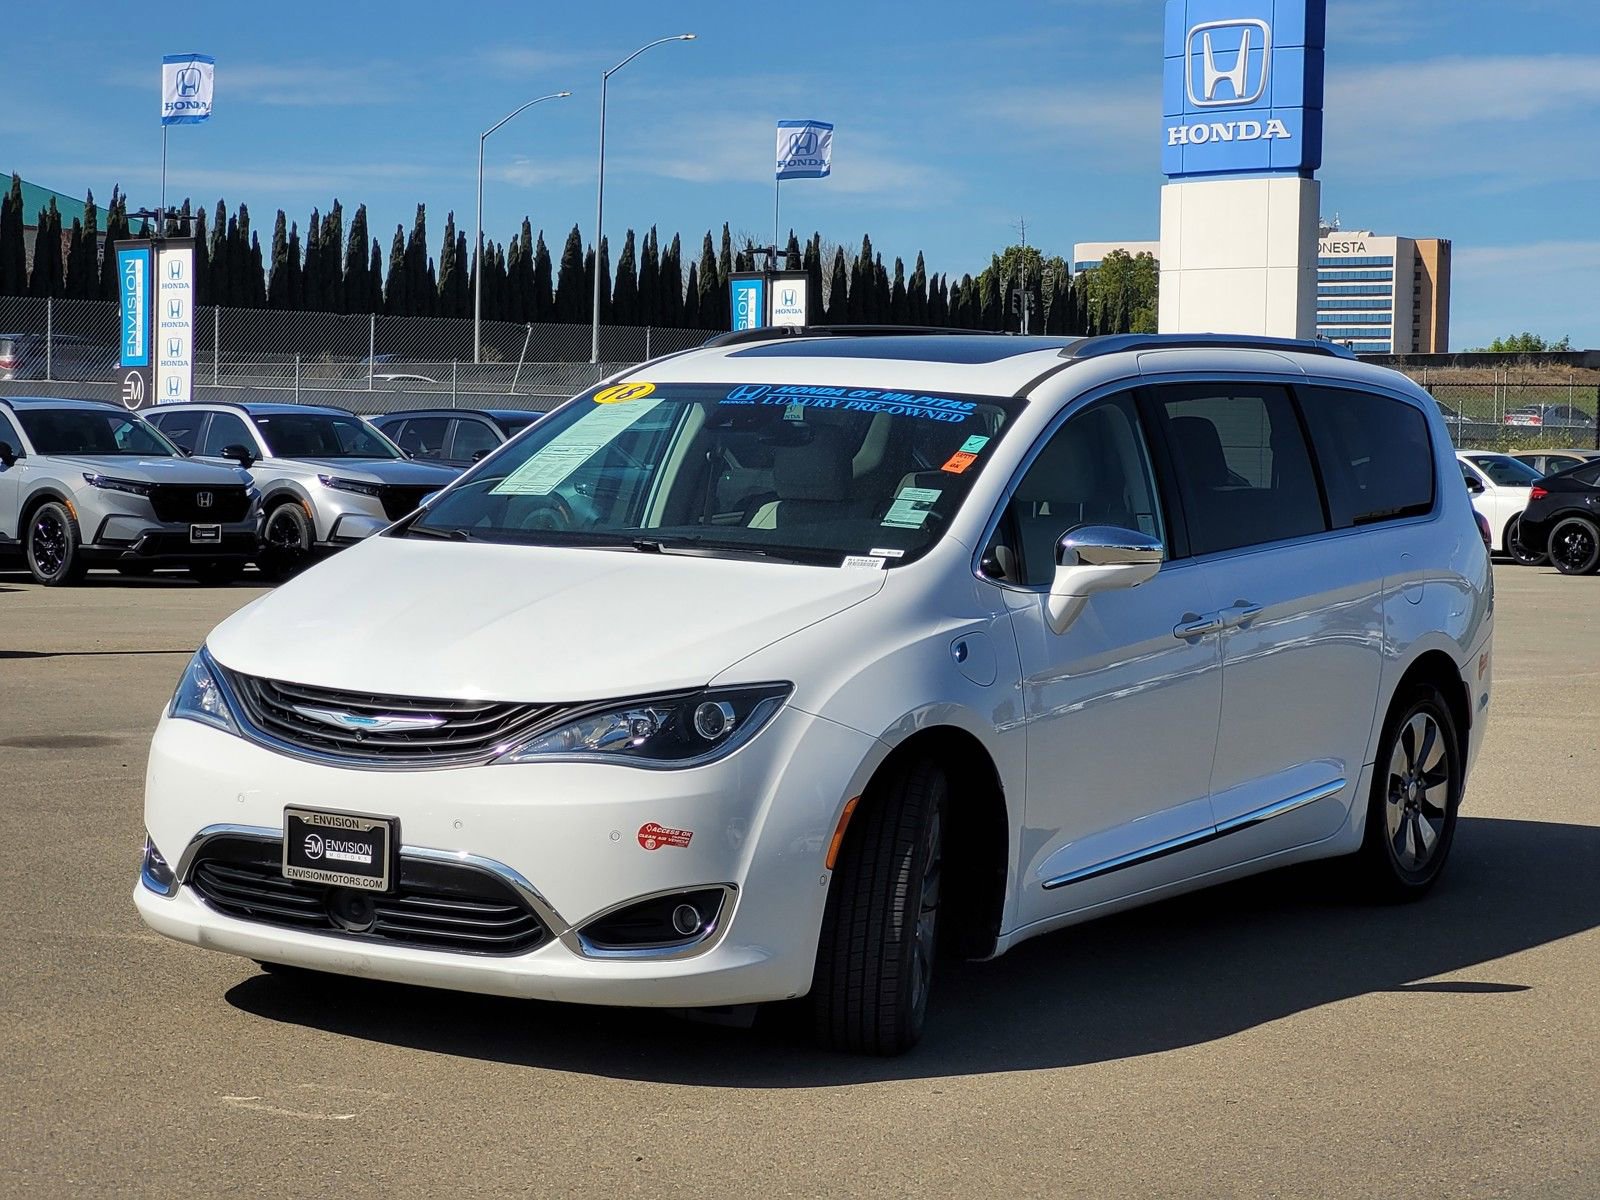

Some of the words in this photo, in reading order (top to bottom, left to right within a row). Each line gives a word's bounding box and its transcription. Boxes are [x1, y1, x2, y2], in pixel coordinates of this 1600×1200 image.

[165, 101, 211, 111] HONDA
[1167, 119, 1291, 146] HONDA
[1318, 241, 1367, 253] NESTA
[125, 259, 137, 357] ENVISION
[738, 288, 748, 330] SION
[773, 386, 847, 396] HONDA
[847, 390, 881, 398] OF
[877, 392, 978, 411] MILPITAS
[761, 396, 845, 409] LUXURY
[842, 401, 966, 423] PRE-OWNED
[313, 815, 359, 829] ENVISION
[652, 827, 680, 835] ACCESS
[325, 839, 372, 855] ENVISION
[329, 852, 368, 861] MOTORS
[287, 868, 383, 889] ENVISIONMOTORS.COM
